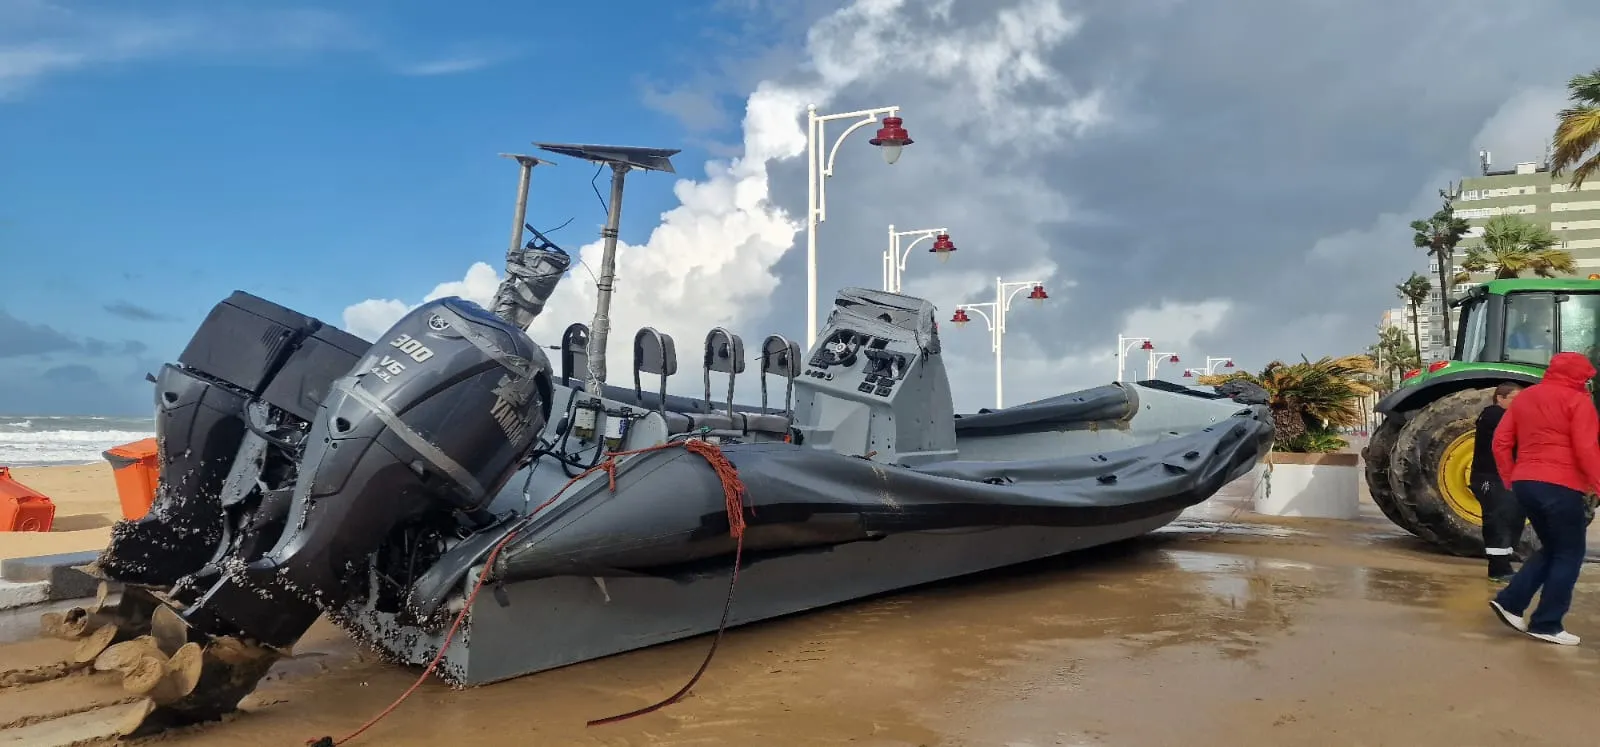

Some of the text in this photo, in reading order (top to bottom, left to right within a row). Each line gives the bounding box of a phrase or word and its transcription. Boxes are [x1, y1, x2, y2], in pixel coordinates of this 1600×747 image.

[389, 333, 434, 363] 300
[380, 355, 406, 375] V6
[490, 396, 522, 449] YAMAHA
